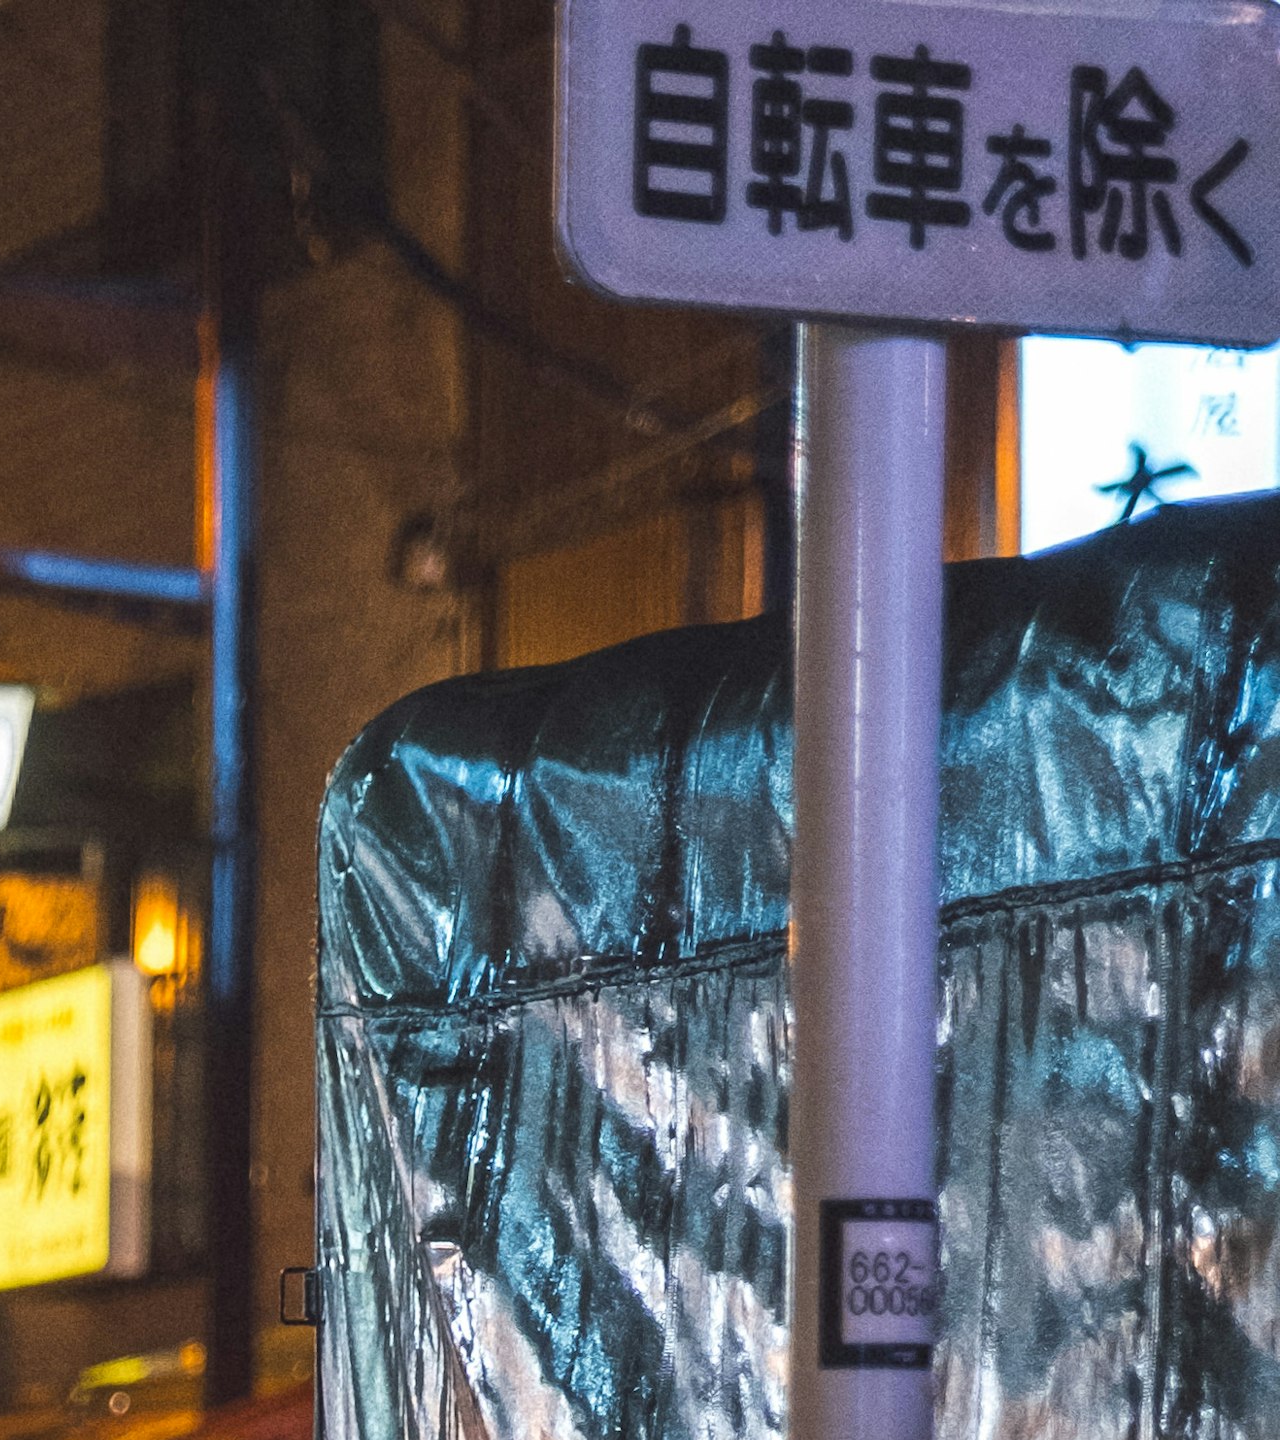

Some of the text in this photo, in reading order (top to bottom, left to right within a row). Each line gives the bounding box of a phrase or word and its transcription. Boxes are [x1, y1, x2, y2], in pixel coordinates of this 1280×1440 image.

[634, 23, 1256, 267] 自転車を除く
